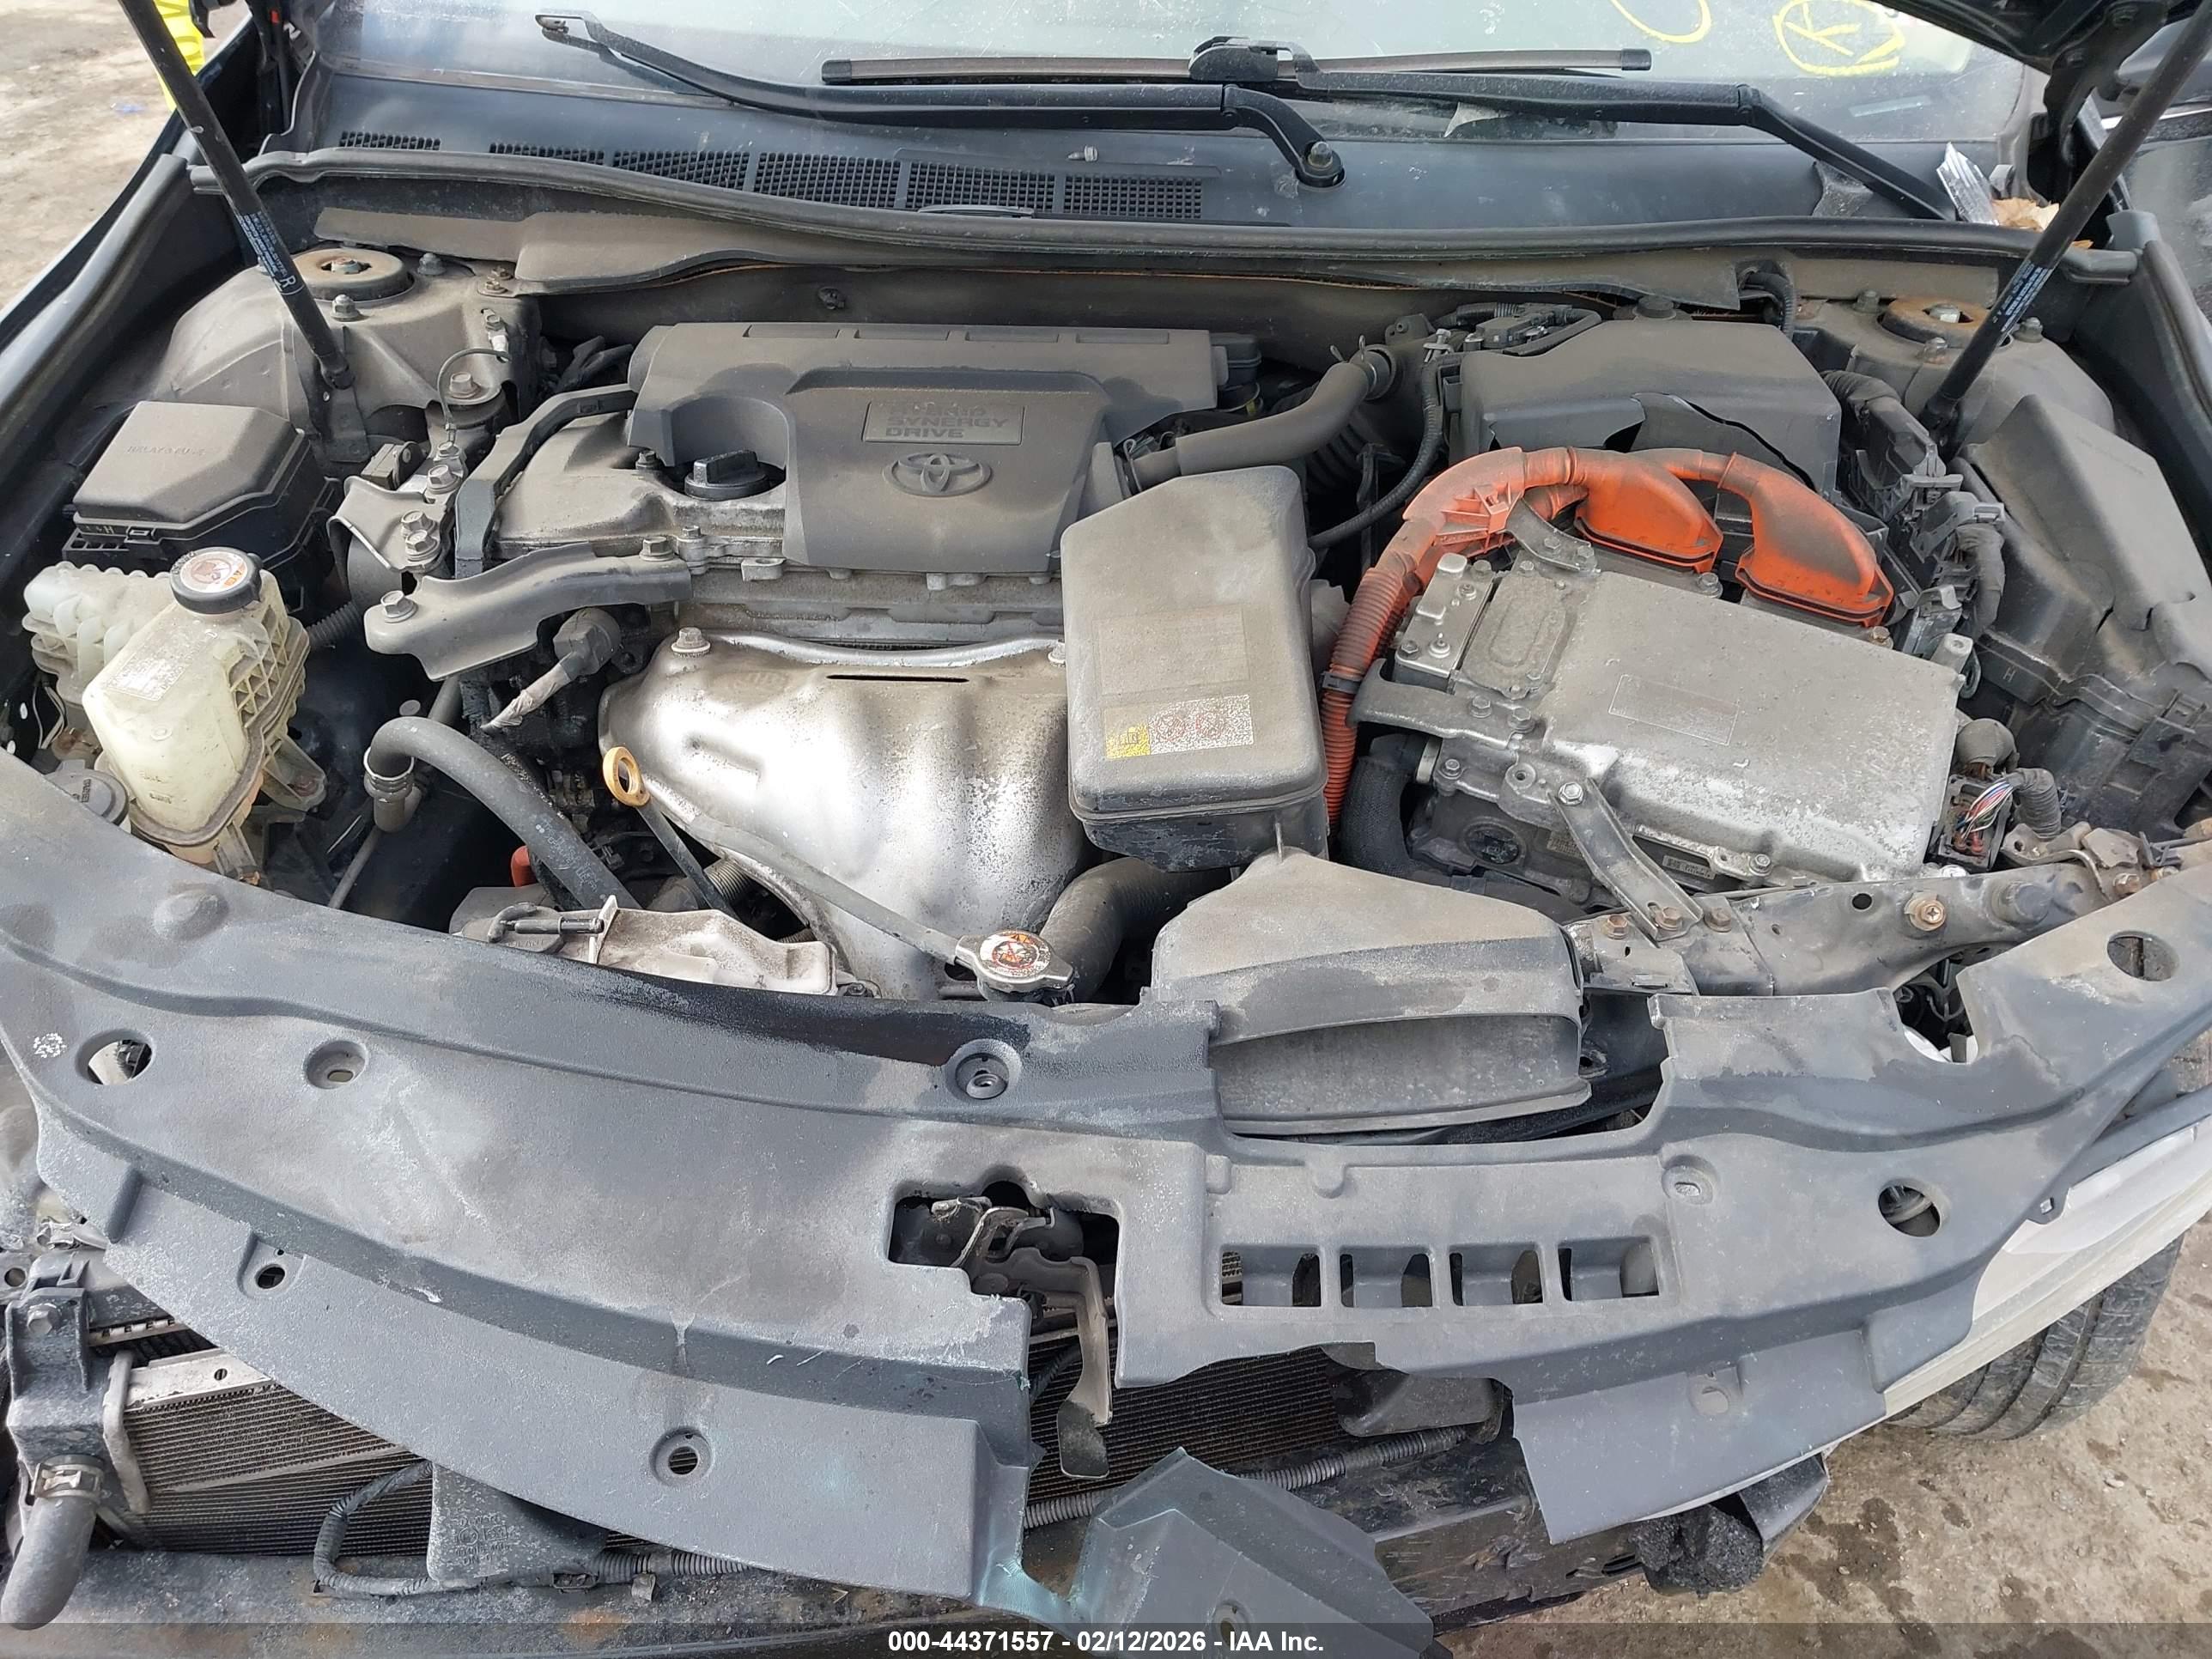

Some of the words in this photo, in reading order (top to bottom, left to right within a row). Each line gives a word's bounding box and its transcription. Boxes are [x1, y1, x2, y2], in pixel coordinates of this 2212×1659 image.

[280, 276, 296, 288] R
[887, 416, 1010, 428] SYNERGY
[885, 427, 964, 439] DRIVE
